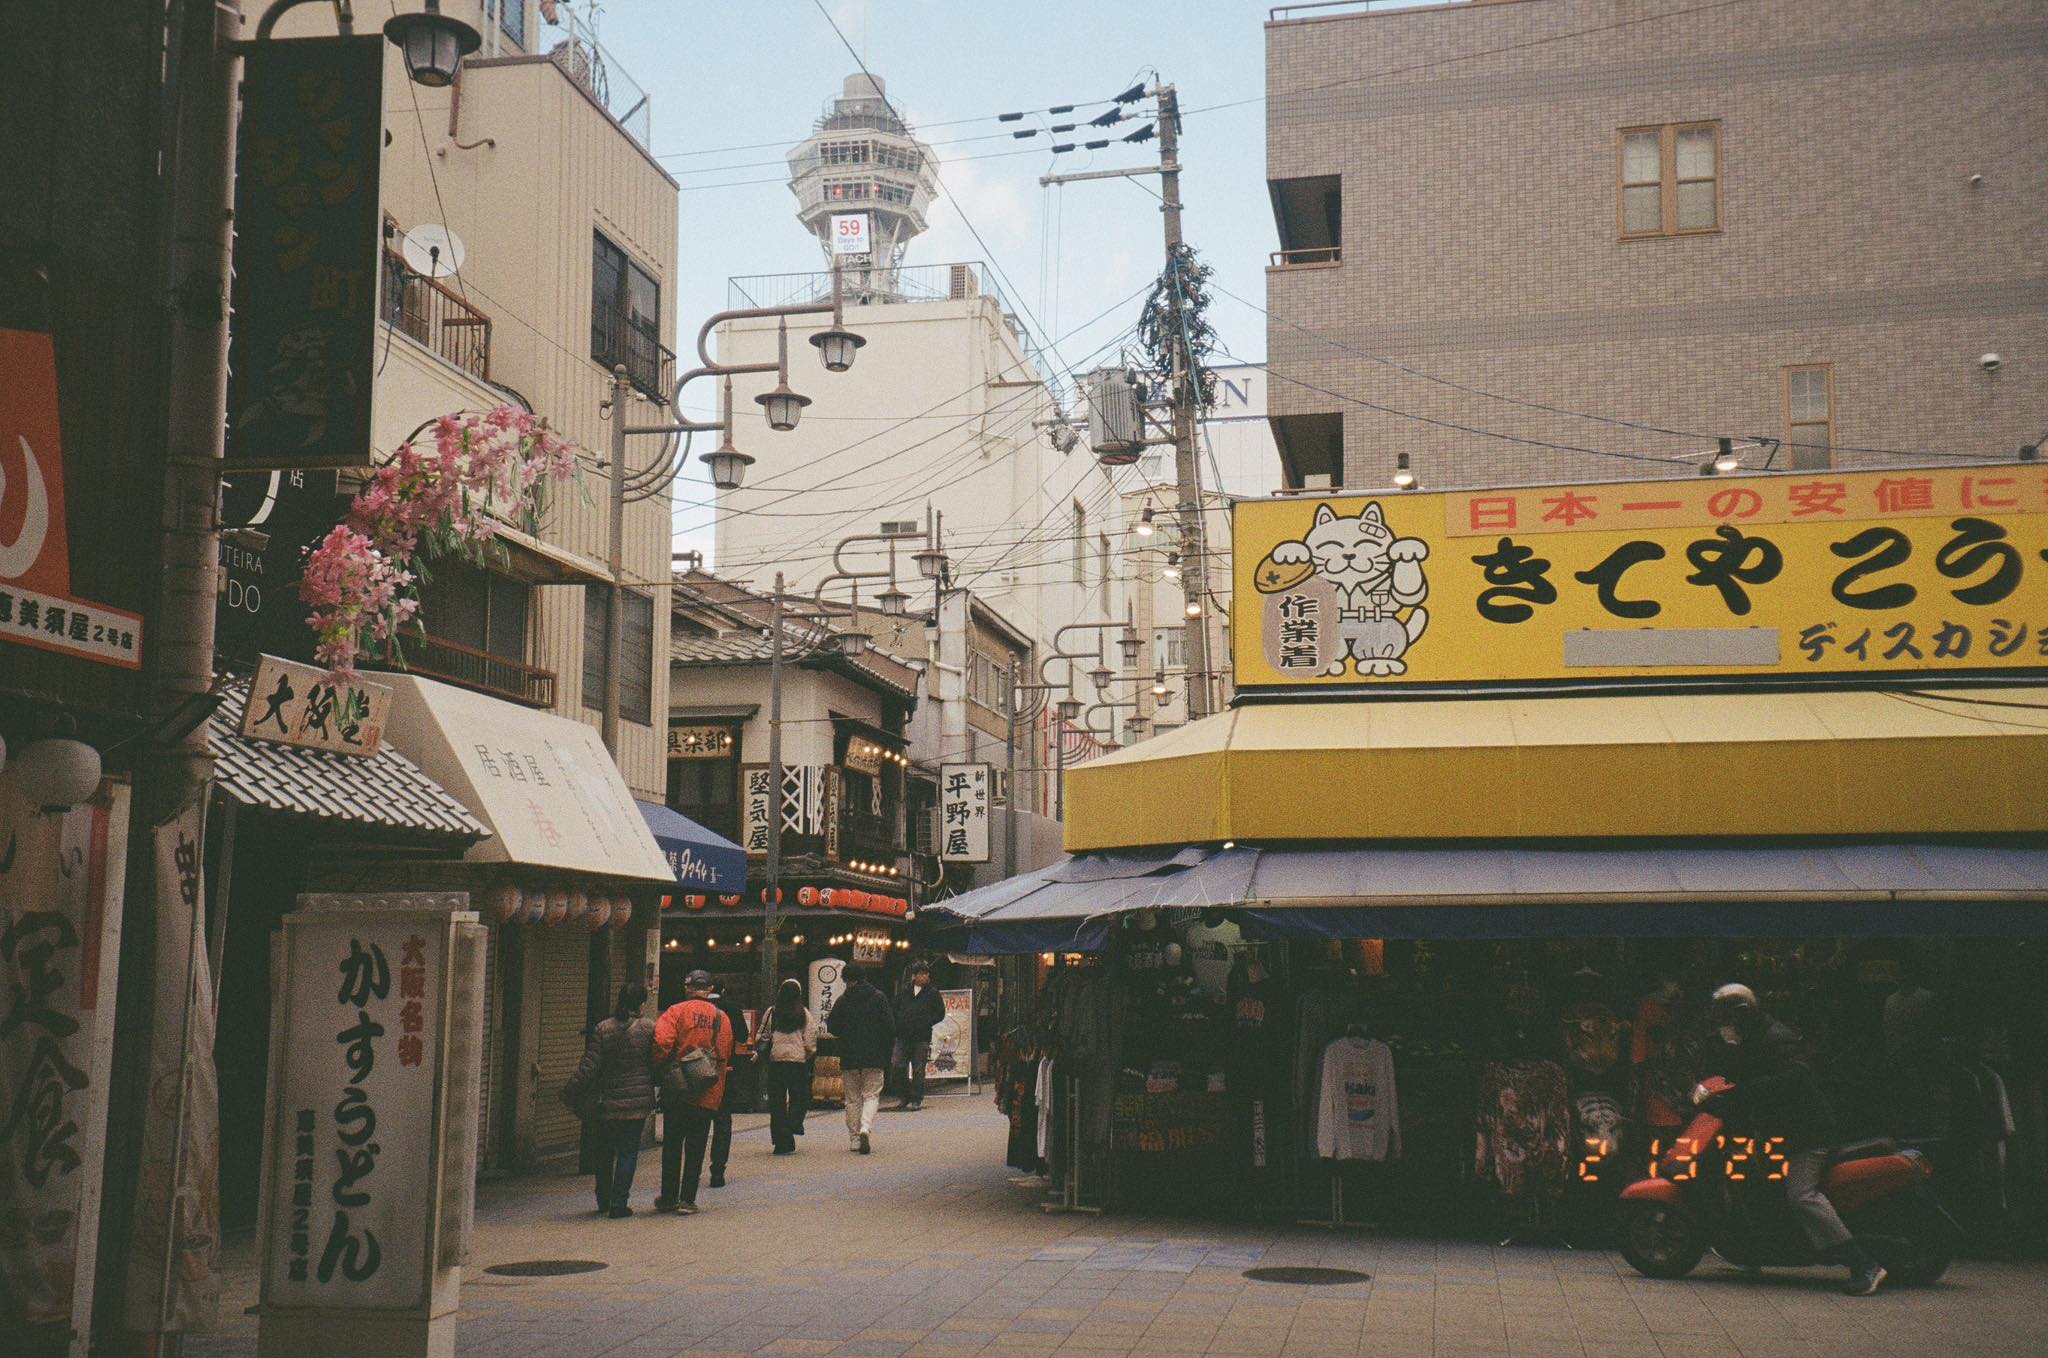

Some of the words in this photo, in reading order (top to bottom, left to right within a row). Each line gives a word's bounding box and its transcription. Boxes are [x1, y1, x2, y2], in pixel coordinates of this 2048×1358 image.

[839, 219, 860, 236] 59
[1470, 476, 2048, 530] 日本一の安値に
[1279, 595, 1318, 668] 作業着
[944, 771, 972, 856] 平野屋
[397, 934, 426, 1068] 大阪名物
[317, 938, 392, 1284] かすうどん
